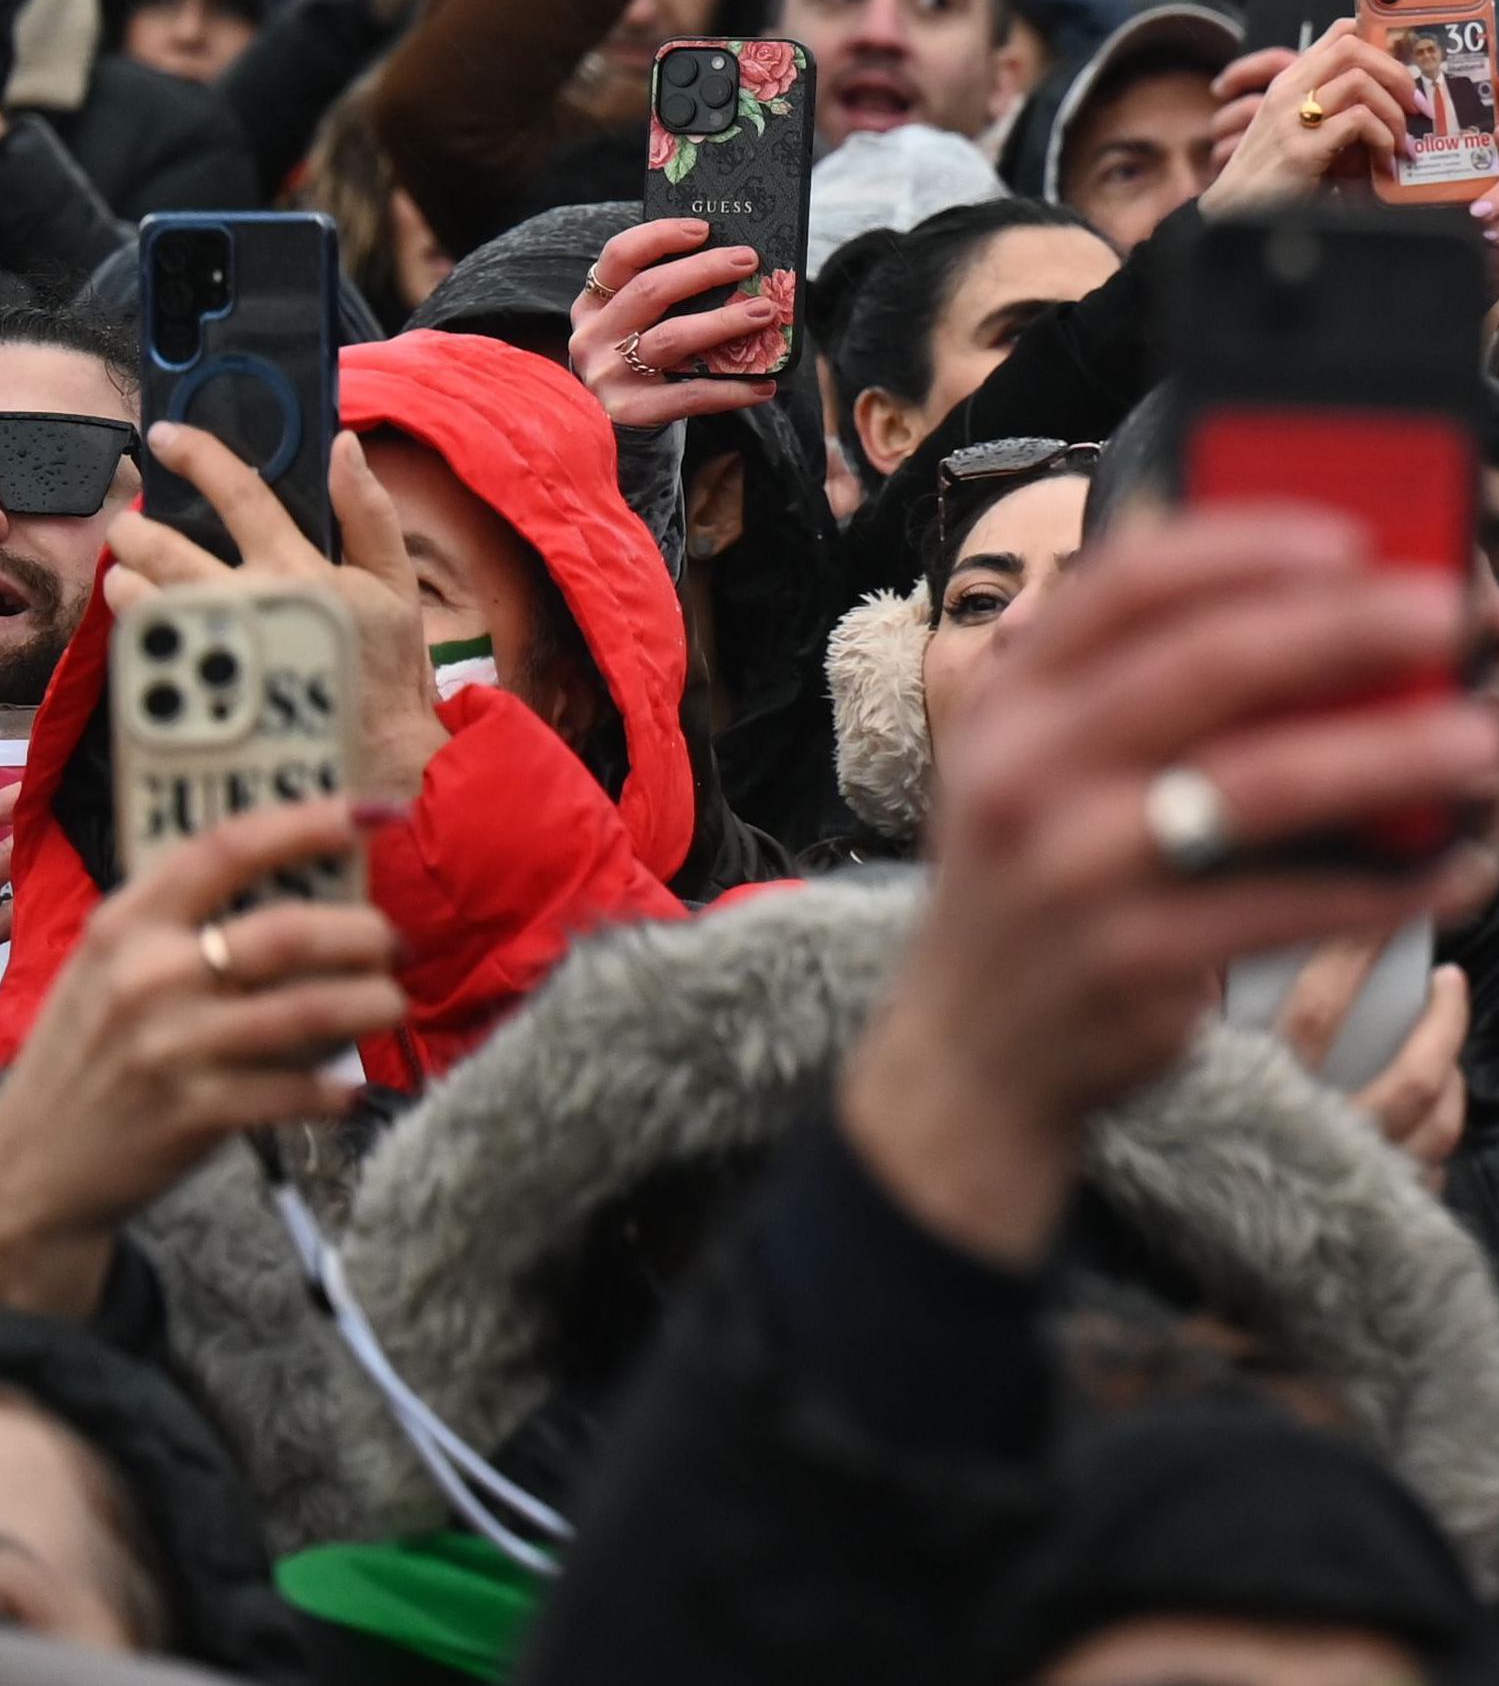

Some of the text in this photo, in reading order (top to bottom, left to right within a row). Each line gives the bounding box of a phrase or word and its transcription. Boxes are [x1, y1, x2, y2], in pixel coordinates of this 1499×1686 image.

[1445, 22, 1484, 54] 30
[1415, 135, 1490, 153] ollow me
[692, 200, 753, 214] GUESS
